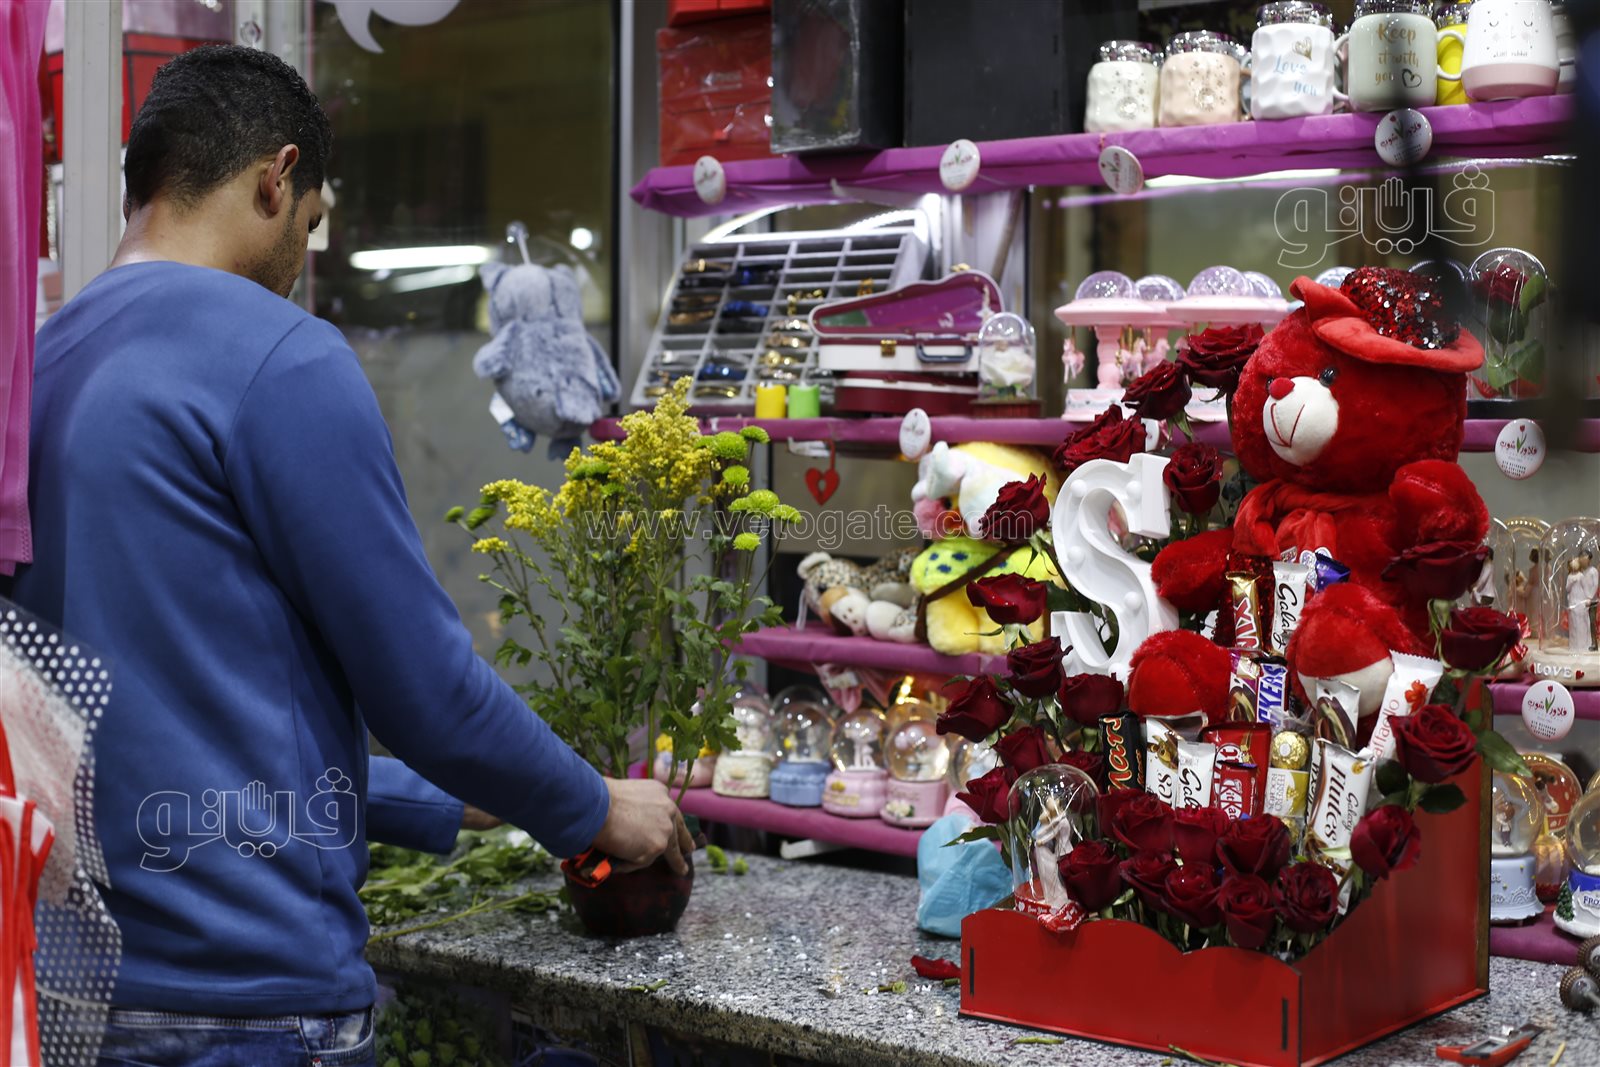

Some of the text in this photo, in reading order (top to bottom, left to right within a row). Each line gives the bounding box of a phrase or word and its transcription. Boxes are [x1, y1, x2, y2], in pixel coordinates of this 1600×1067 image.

[1376, 22, 1416, 46] Keep
[1273, 55, 1307, 76] Love
[1294, 80, 1317, 96] you
[1272, 582, 1298, 650] Galay
[1535, 661, 1573, 679] LOVE
[1371, 698, 1400, 758] affaello
[1324, 764, 1347, 842] Flutes
[1341, 792, 1359, 832] Galaxy
[1583, 895, 1600, 906] FRO
